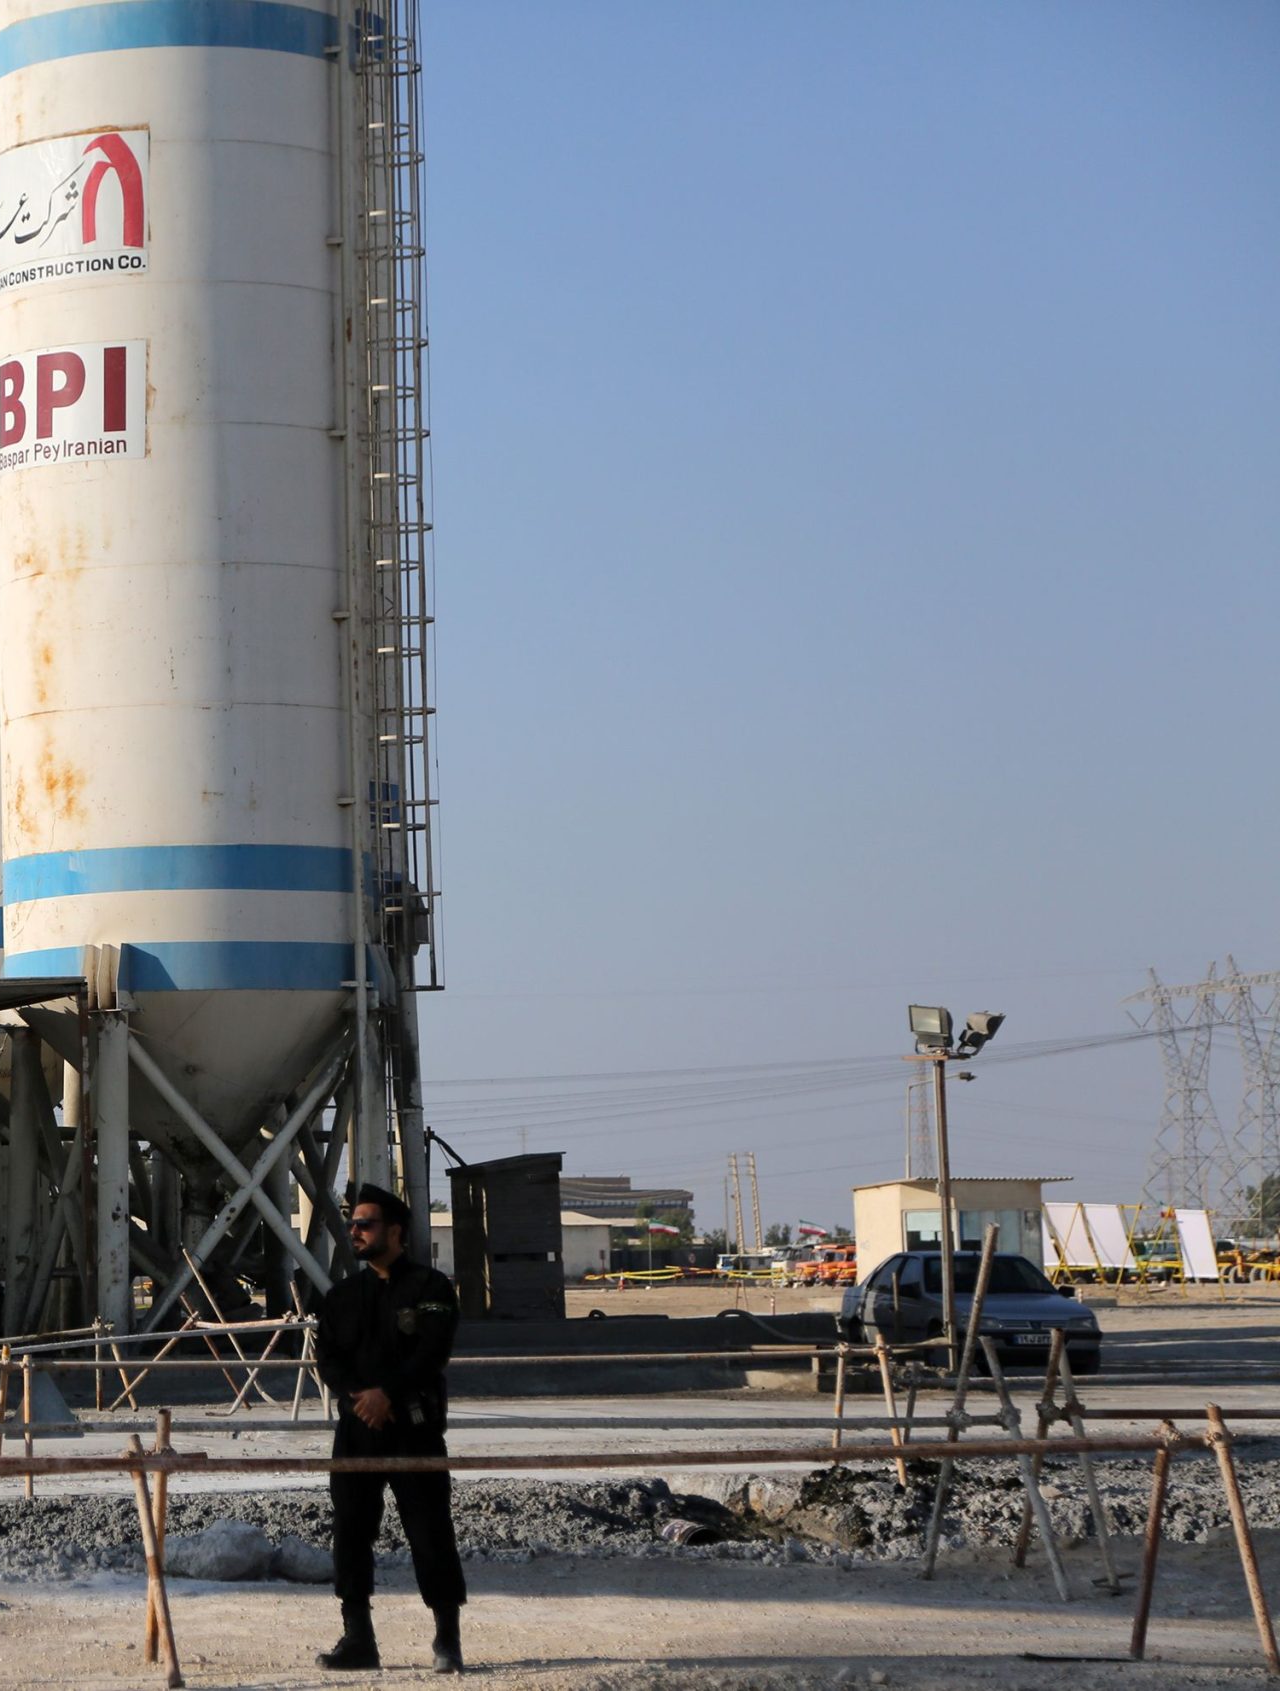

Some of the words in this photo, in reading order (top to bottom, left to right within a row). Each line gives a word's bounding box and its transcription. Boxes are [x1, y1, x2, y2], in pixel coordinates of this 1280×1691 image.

[8, 257, 114, 286] CONSTRUCTION
[0, 346, 127, 449] BPI
[0, 447, 30, 471] Baspar
[34, 443, 60, 462] Pey
[63, 438, 127, 457] Iranian
